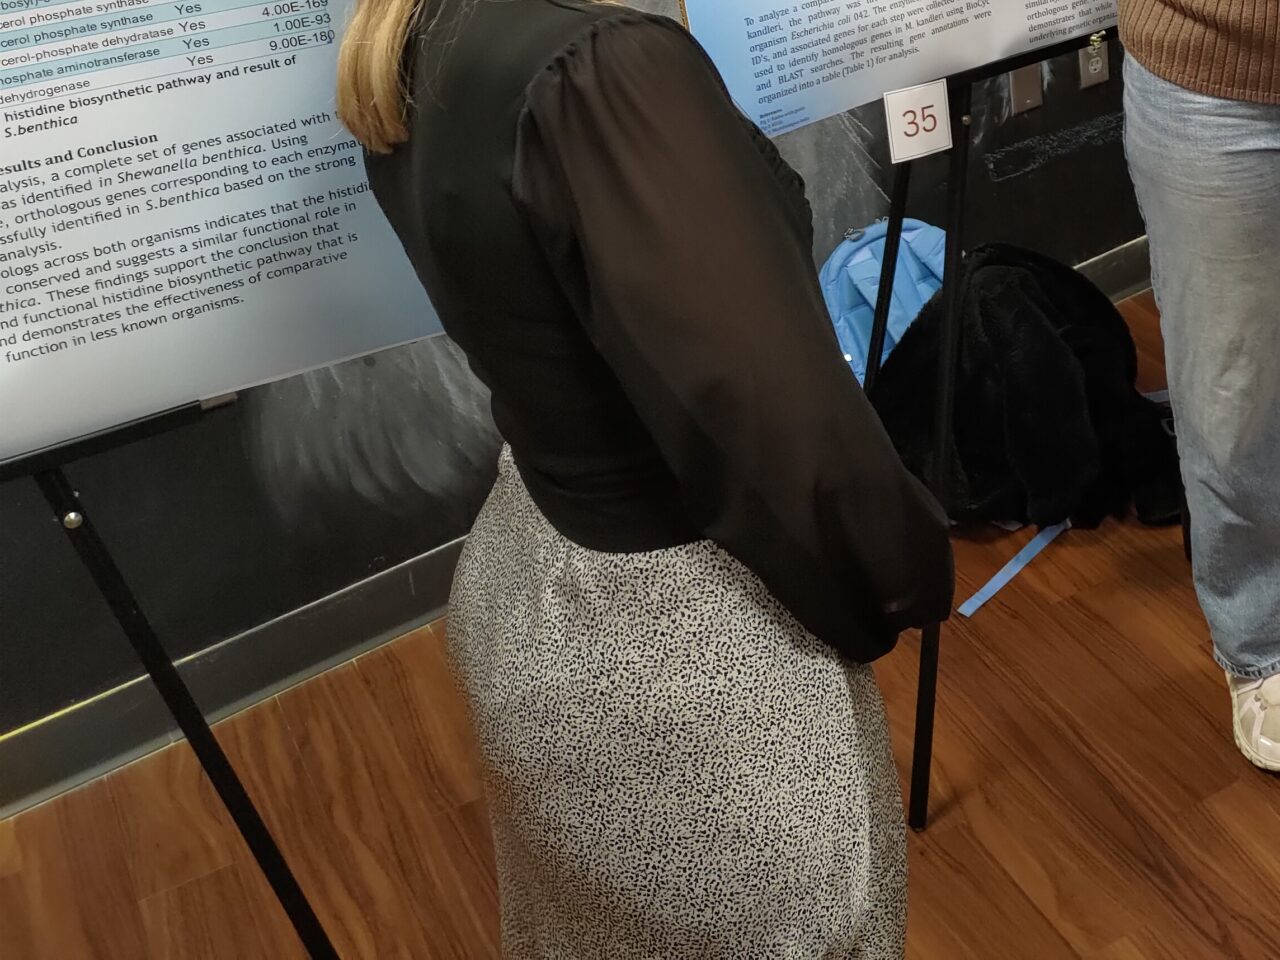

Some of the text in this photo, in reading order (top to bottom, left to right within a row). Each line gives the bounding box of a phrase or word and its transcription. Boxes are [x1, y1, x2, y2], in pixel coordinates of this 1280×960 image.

[4, 56, 297, 124] histidine biosynthetic pathway and result of
[5, 116, 78, 137] S.benthica
[902, 104, 939, 140] 35
[0, 134, 158, 176] esults and Conclusion
[5, 295, 245, 363] function in less known organisms.
